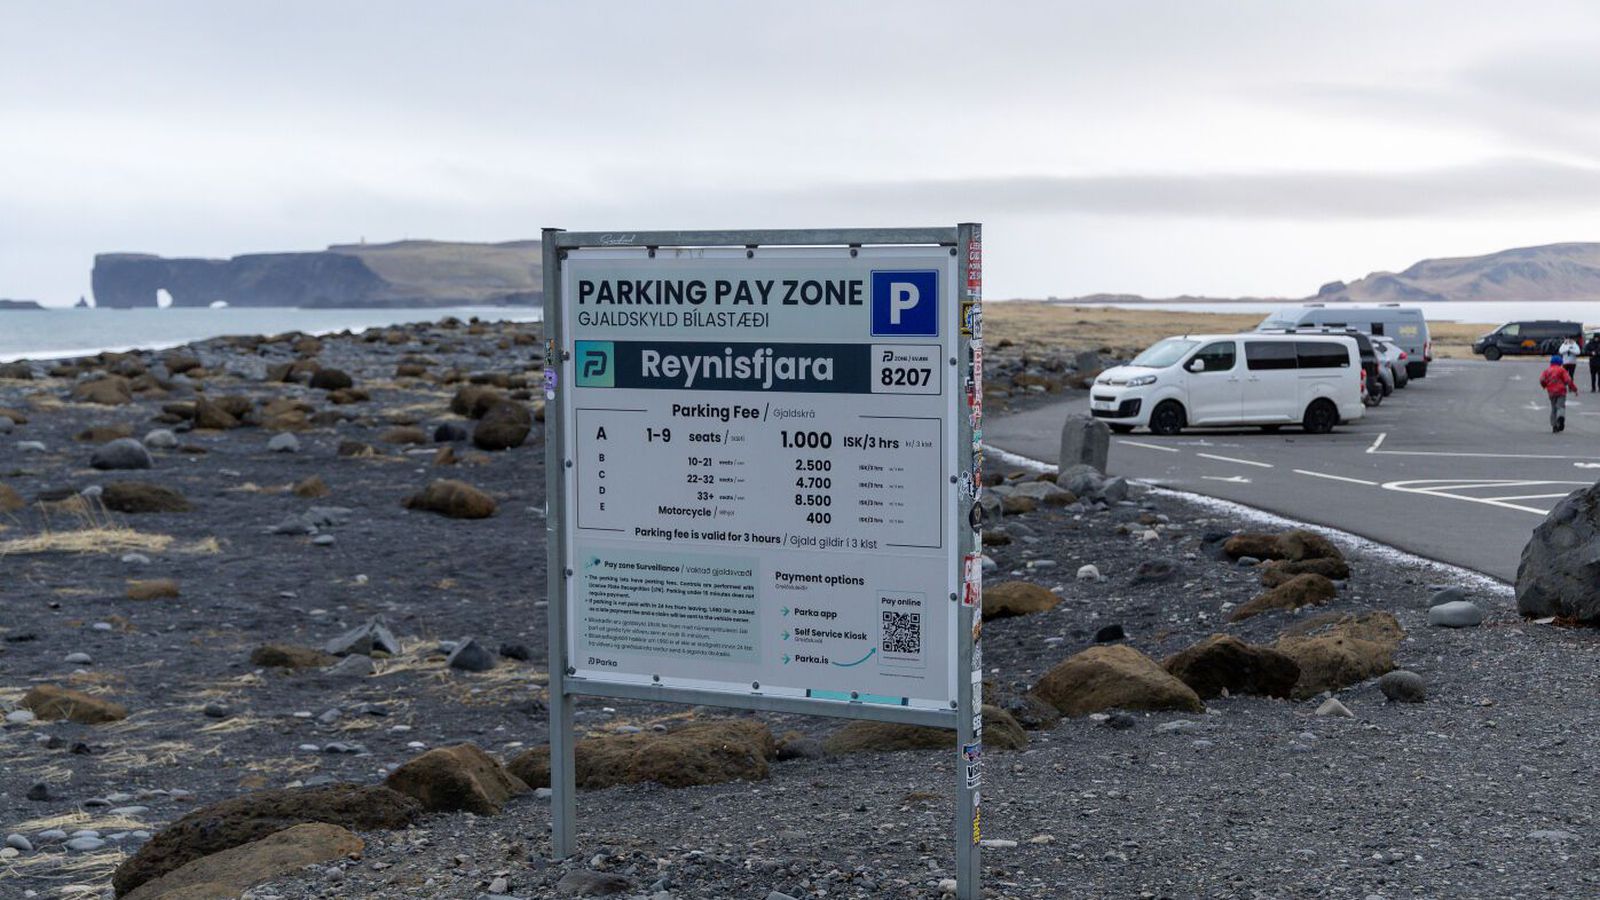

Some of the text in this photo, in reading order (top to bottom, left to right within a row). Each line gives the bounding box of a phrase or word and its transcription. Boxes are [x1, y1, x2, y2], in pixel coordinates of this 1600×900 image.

[578, 280, 863, 305] PARKING PAY ZONE
[890, 282, 920, 325] P
[578, 308, 769, 327] GJALDSKYLD BÍLASTÆÐI
[641, 347, 834, 389] Reynisfjara
[881, 368, 932, 387] 8207
[672, 403, 730, 422] Parking
[733, 405, 760, 418] Fee
[773, 408, 816, 420] Gjaldskrá
[596, 426, 608, 440] A
[646, 428, 671, 442] 1-9
[689, 431, 721, 442] seats
[780, 431, 832, 449] 1.000
[843, 433, 876, 450] ISK/3
[879, 437, 900, 449] hrs
[599, 454, 605, 462] B
[688, 456, 712, 467] 10-21
[795, 459, 832, 472] 2.500
[598, 470, 606, 479] C
[687, 474, 714, 484] 22-32
[795, 476, 832, 489] 4.700
[599, 486, 606, 494] D
[697, 492, 714, 500] 33+
[794, 494, 832, 506] 8.500
[600, 502, 605, 511] E
[658, 506, 712, 518] Motorcycle
[806, 512, 832, 524] 400
[635, 528, 672, 540] Parking
[674, 529, 690, 538] fee
[691, 530, 700, 539] is
[702, 531, 726, 541] valid
[728, 532, 742, 542] for
[744, 533, 750, 542] 3
[752, 534, 781, 544] hours
[790, 535, 816, 548] Gjald
[818, 537, 844, 549] gildir
[852, 538, 858, 548] 3
[860, 539, 878, 549] klst
[604, 560, 618, 570] Pay
[636, 562, 680, 572] Surveillance
[775, 571, 865, 586] Payment options
[882, 597, 896, 606] Pay
[794, 608, 818, 616] Parka
[794, 628, 868, 640] Self Service Kiosk
[596, 658, 618, 667] Parka
[795, 654, 829, 664] Parka.is
